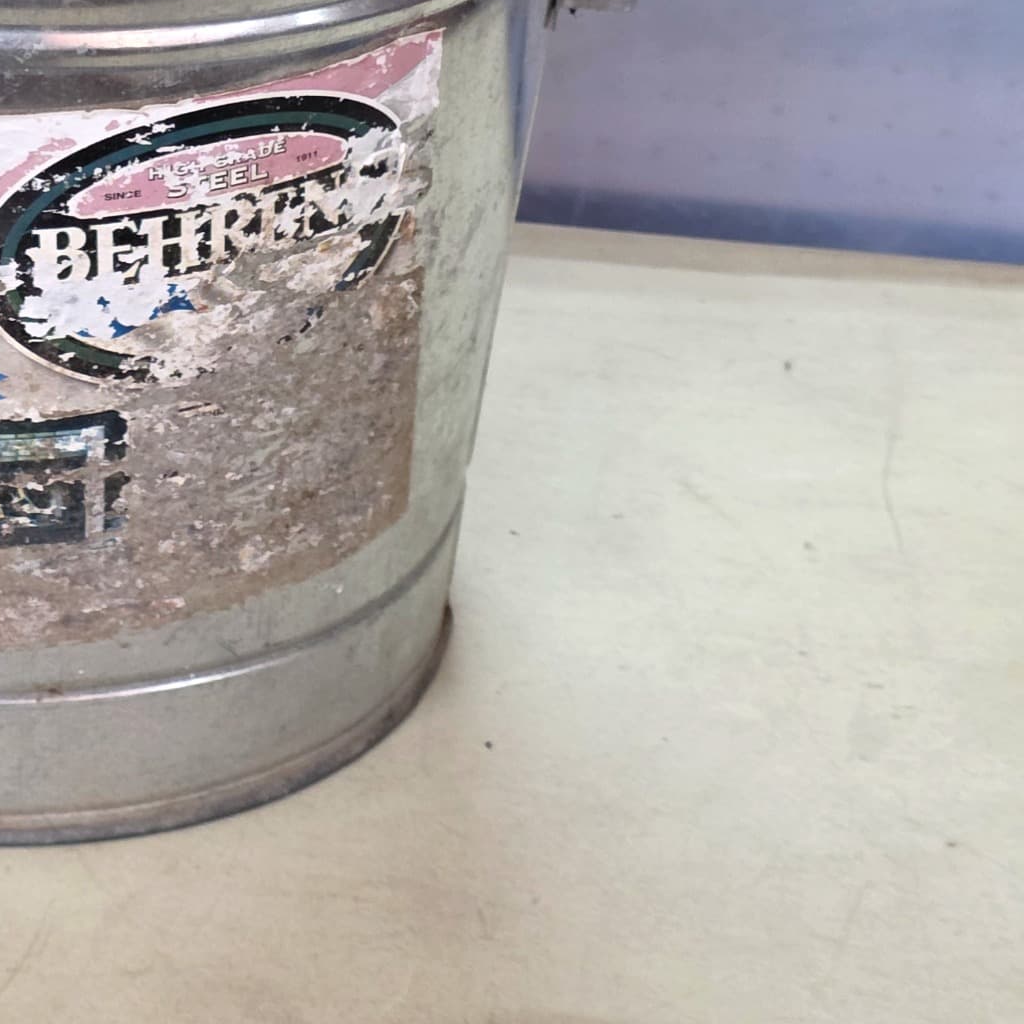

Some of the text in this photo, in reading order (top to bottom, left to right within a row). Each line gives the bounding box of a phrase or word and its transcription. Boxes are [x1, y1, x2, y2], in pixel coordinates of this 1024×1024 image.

[214, 138, 287, 168] GRADE
[103, 190, 143, 202] SINCE
[167, 164, 270, 200] STEEL
